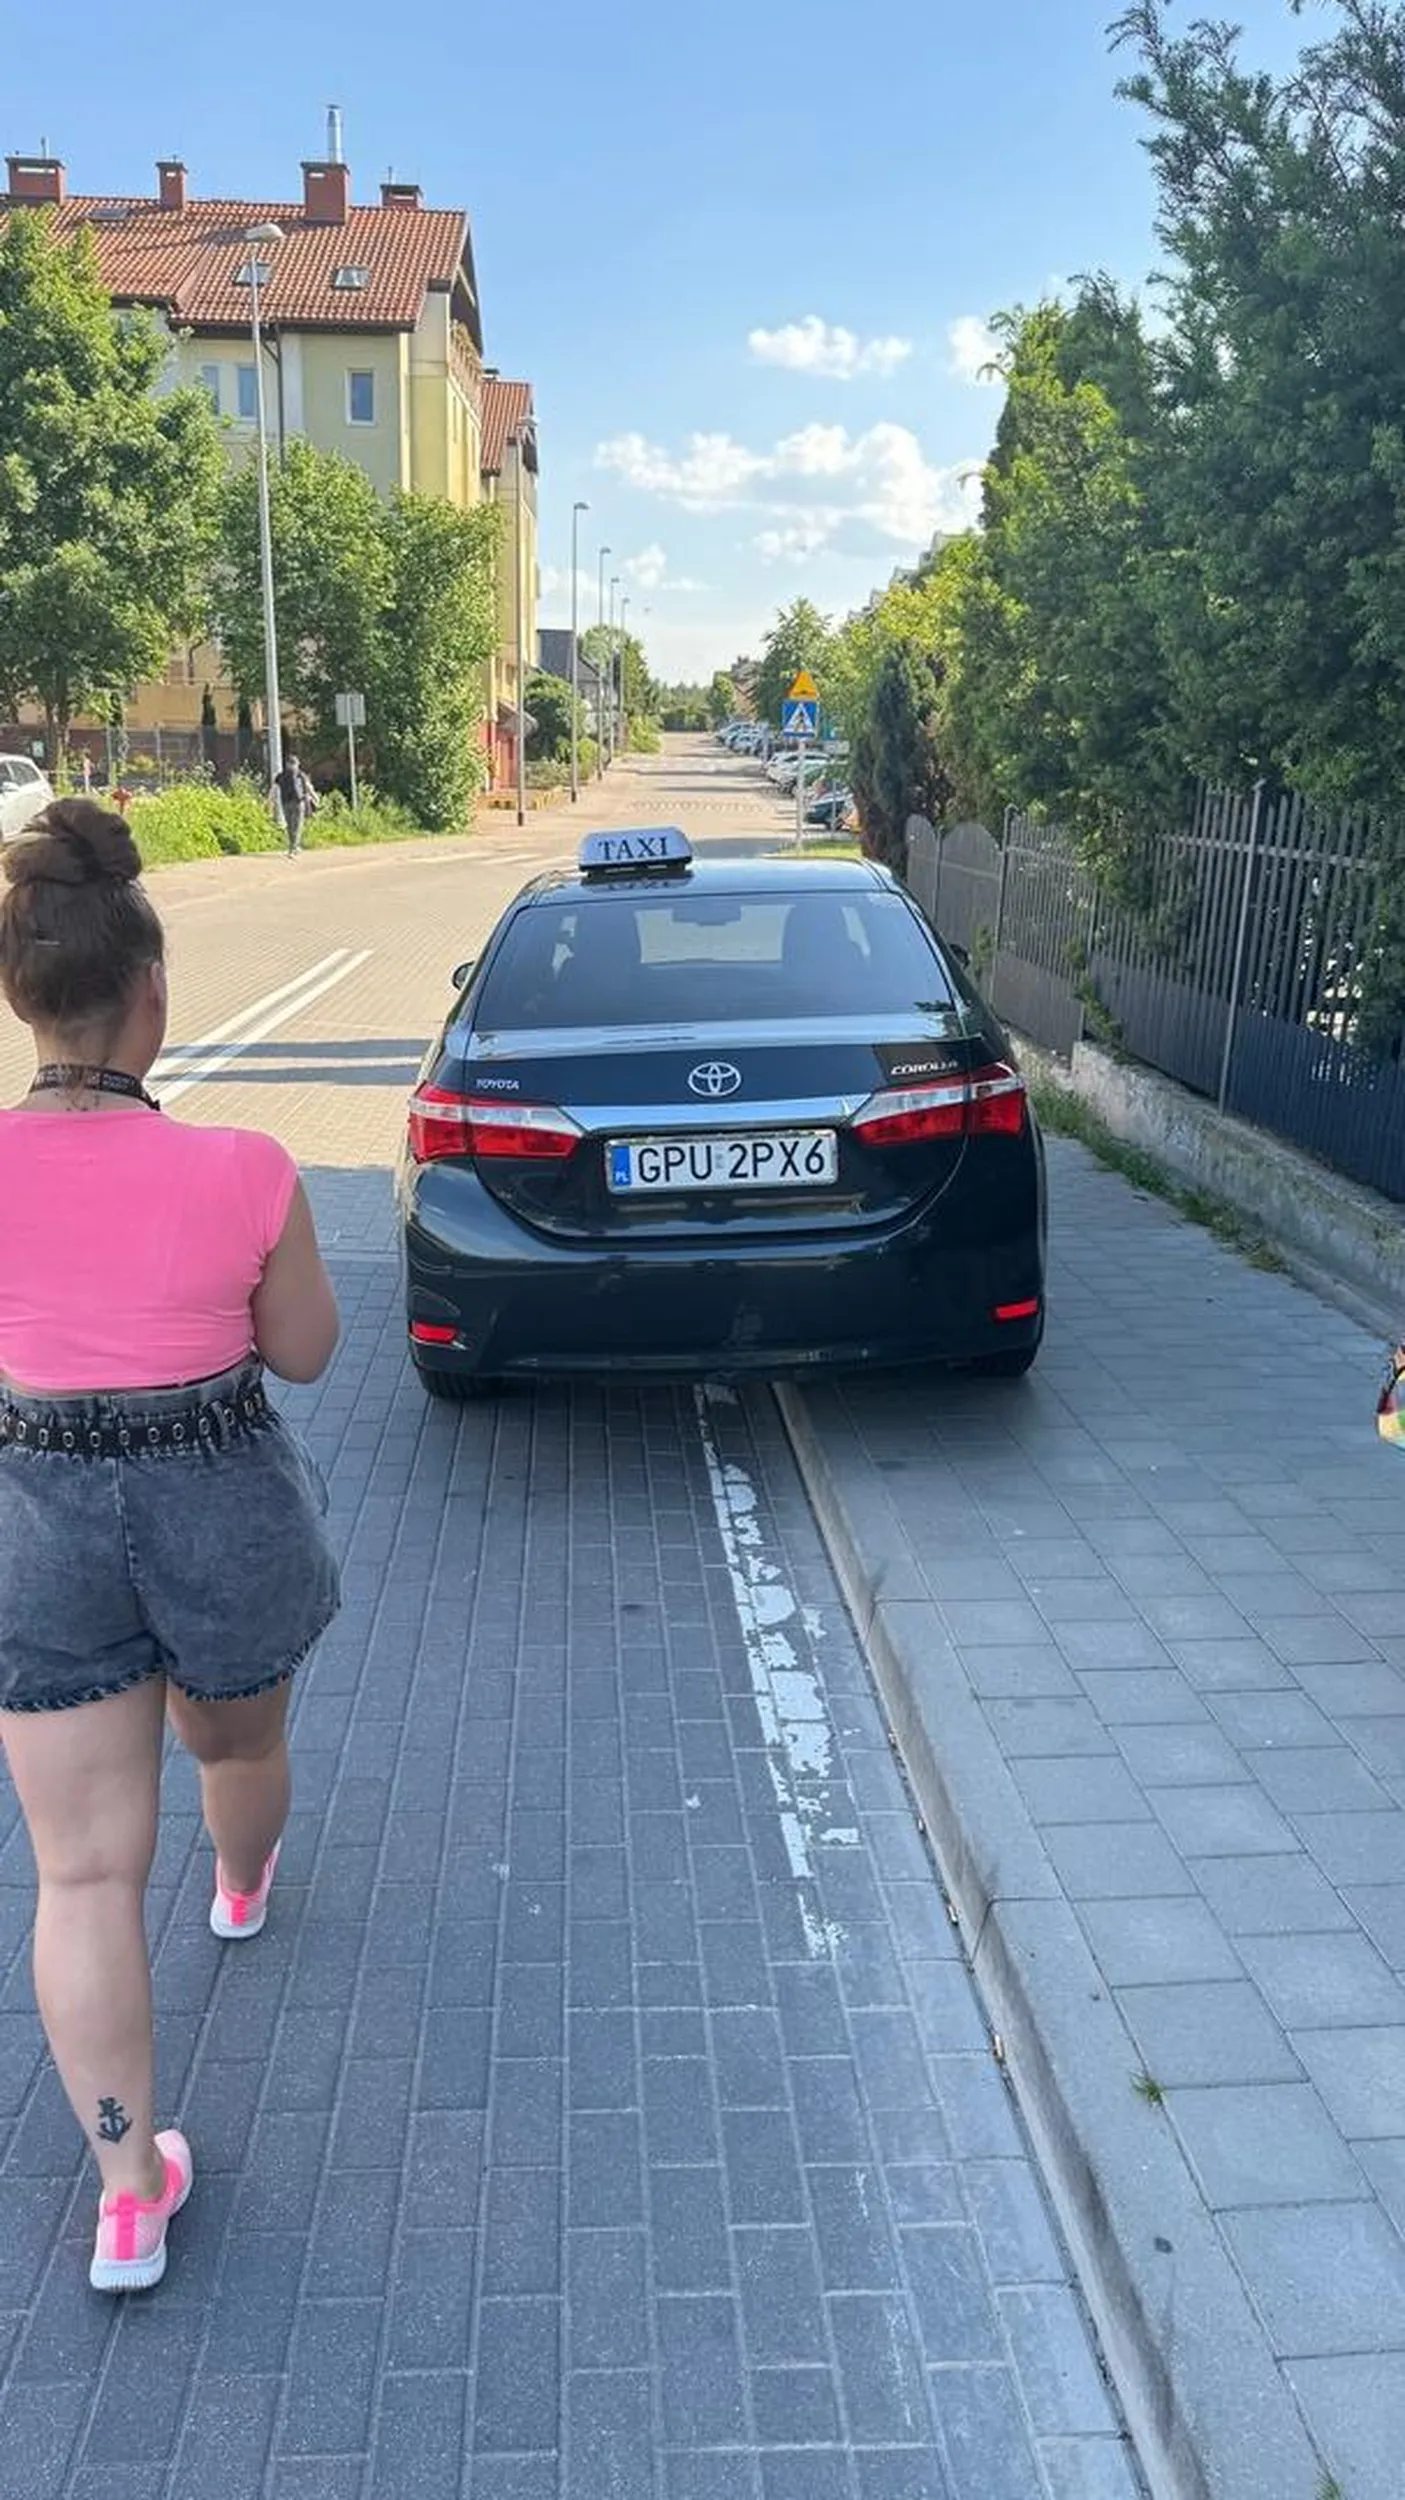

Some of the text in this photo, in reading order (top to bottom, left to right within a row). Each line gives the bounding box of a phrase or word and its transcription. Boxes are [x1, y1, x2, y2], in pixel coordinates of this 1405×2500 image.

[598, 836, 668, 860] TAXI
[638, 1139, 825, 1183] GPU 2PX6
